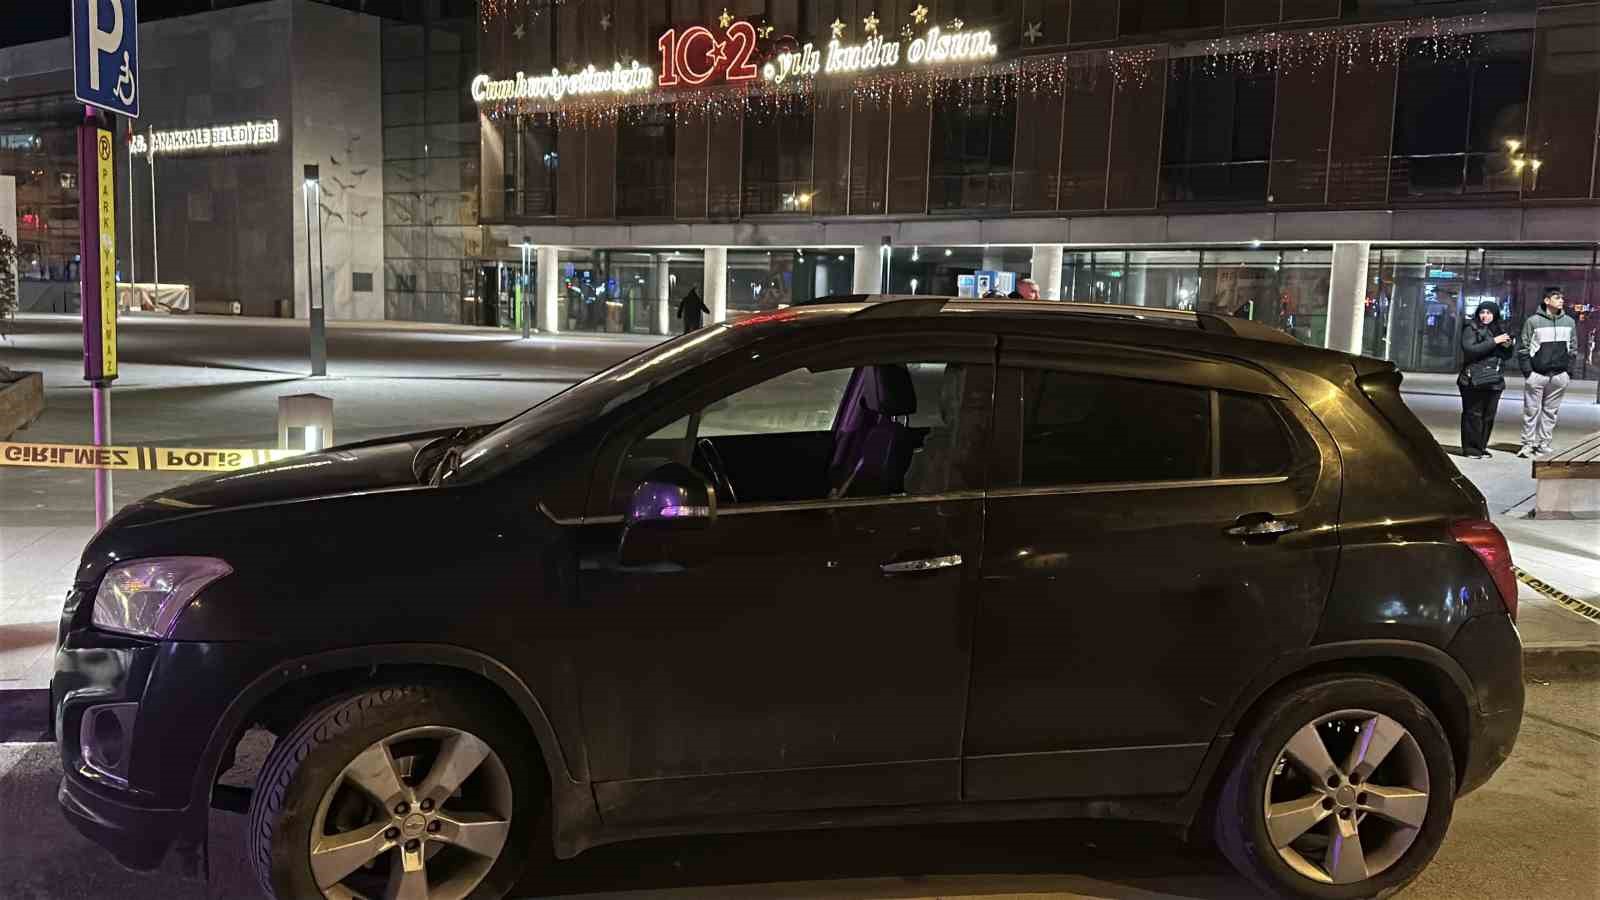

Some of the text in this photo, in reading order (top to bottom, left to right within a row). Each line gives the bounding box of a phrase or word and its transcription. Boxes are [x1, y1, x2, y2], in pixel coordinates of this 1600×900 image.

[88, 0, 124, 91] P
[825, 34, 900, 73] kutlu
[907, 25, 998, 64] olsun.
